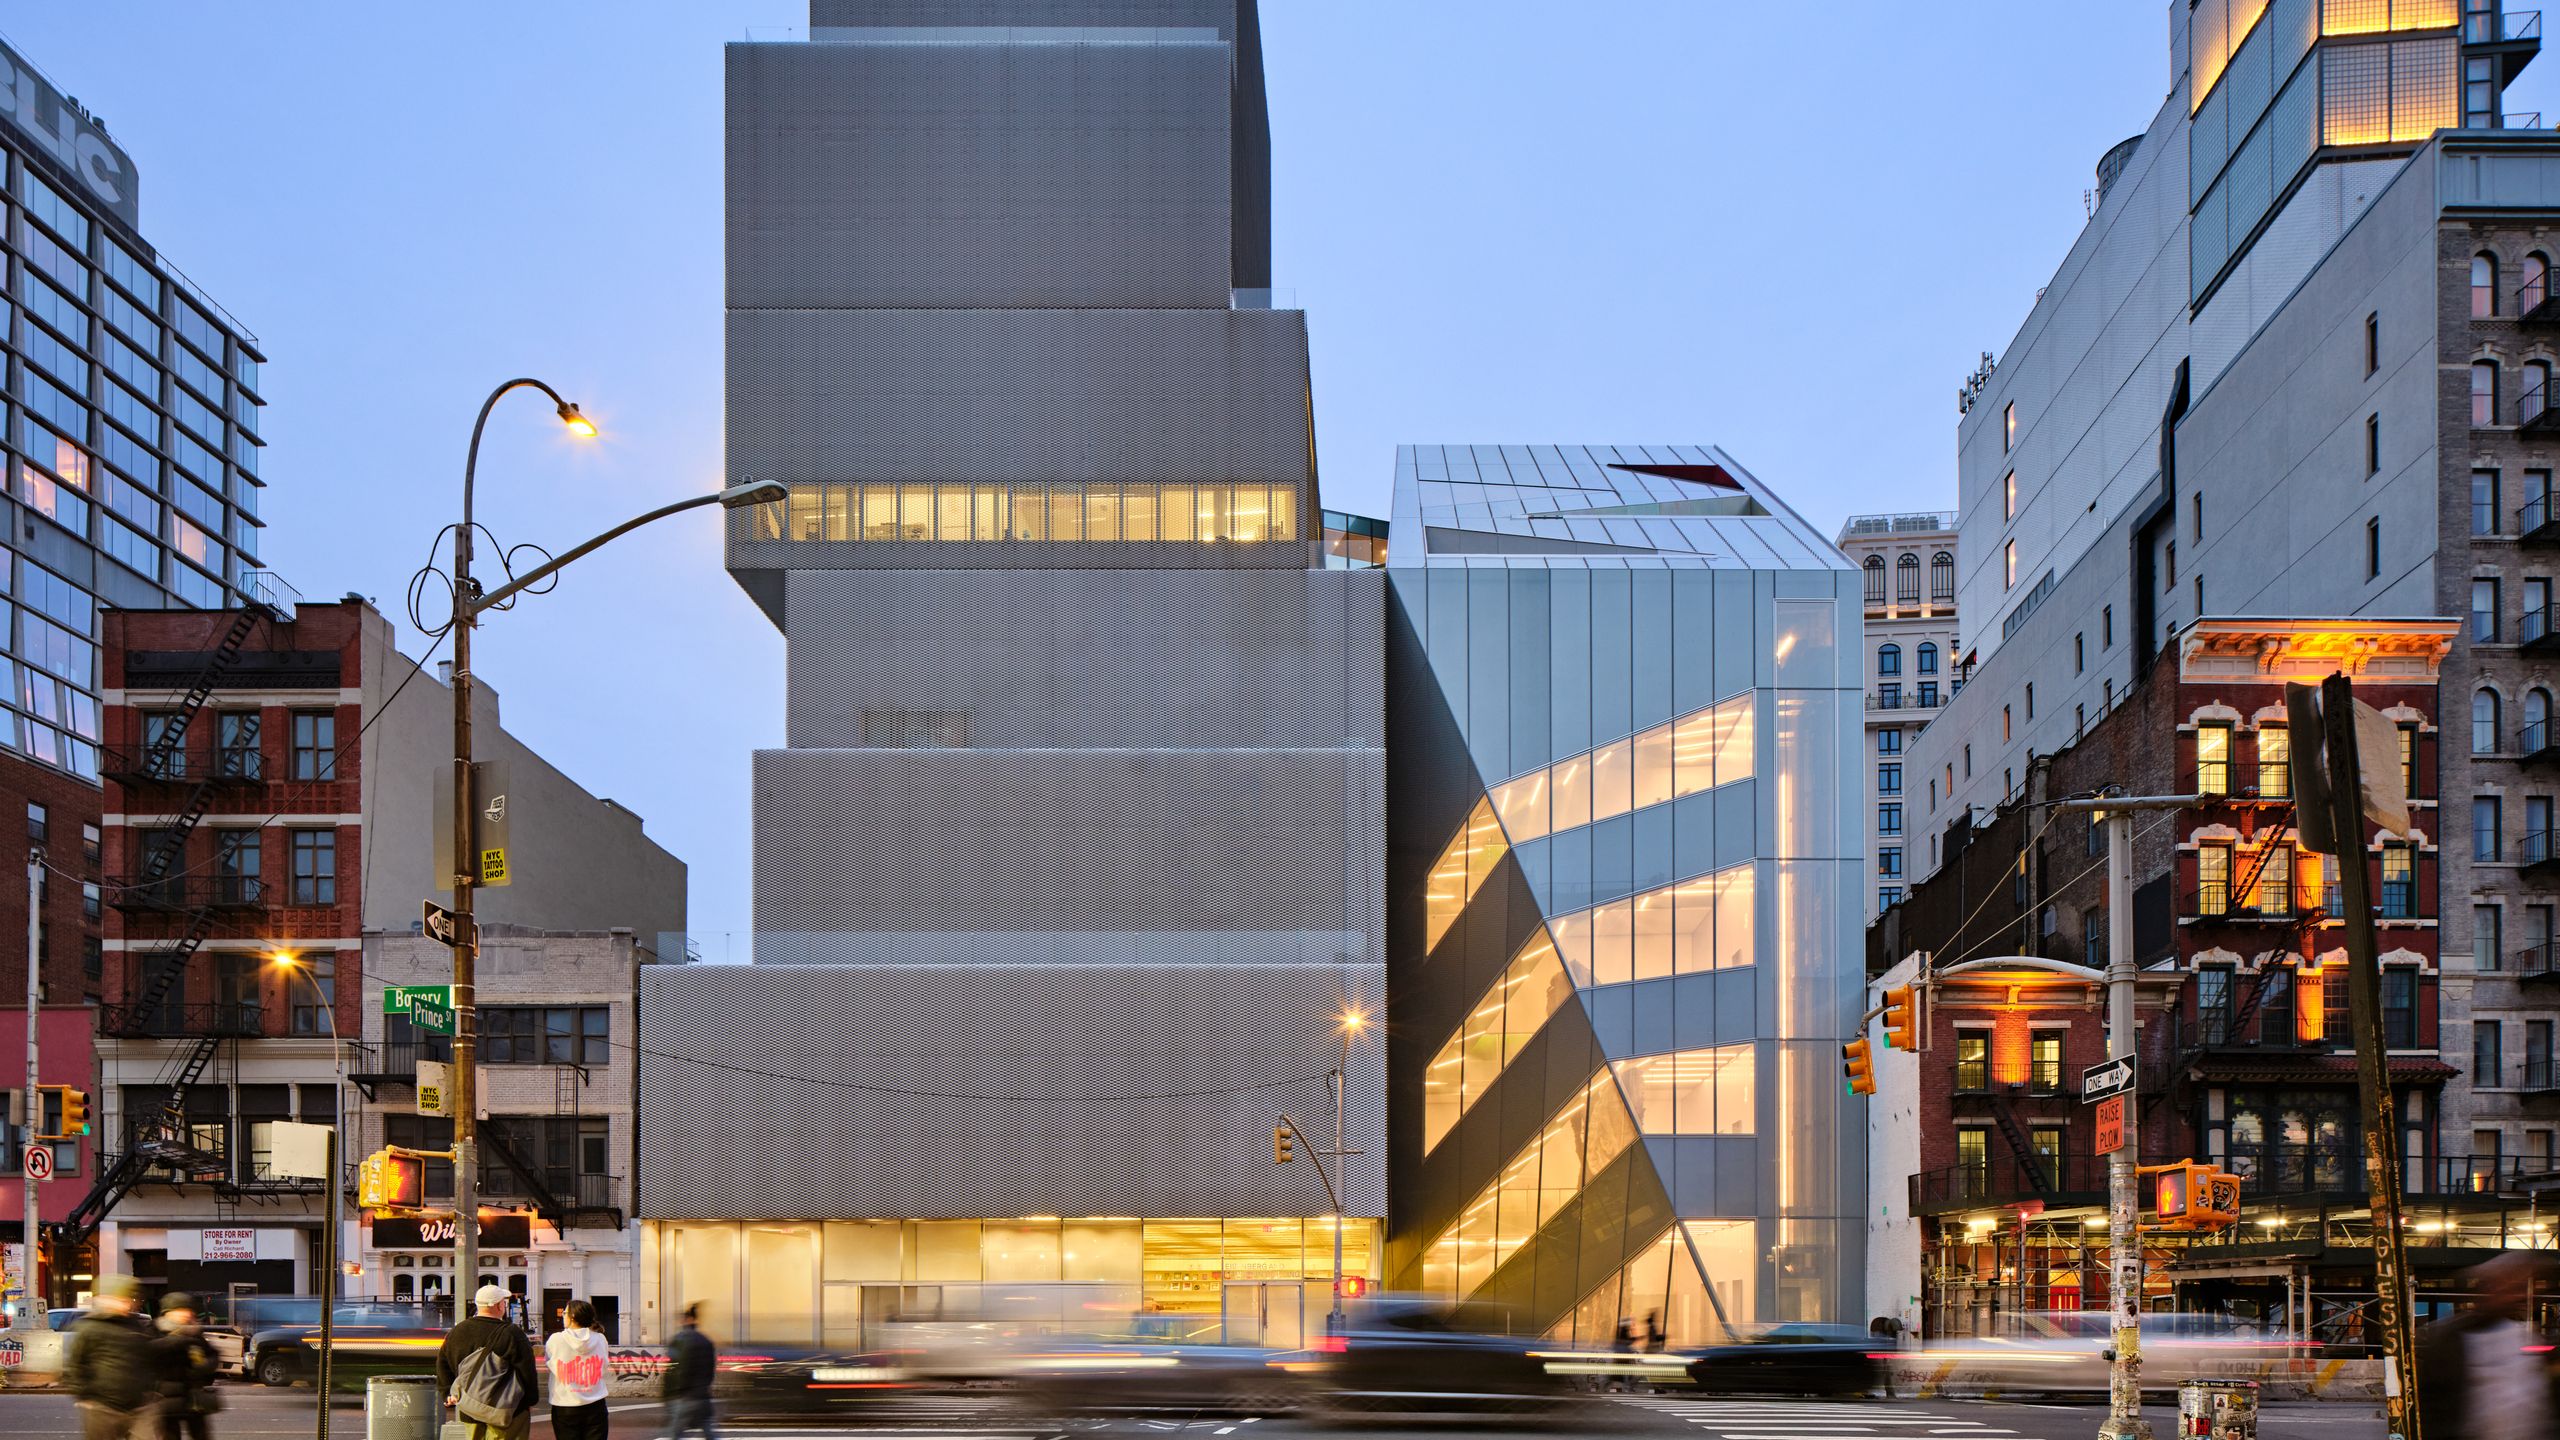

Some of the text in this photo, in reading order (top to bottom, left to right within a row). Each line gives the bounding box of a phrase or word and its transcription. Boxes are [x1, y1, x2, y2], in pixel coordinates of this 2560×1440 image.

[486, 851, 500, 860] NYC
[484, 860, 503, 870] TATTOO
[485, 870, 504, 879] SHOP
[433, 916, 449, 934] ONE
[415, 1002, 452, 1028] Prince St
[2088, 1068, 2124, 1091] ONE WAY
[421, 1094, 439, 1102] TATTOO
[2100, 1104, 2120, 1126] RAISE
[2100, 1128, 2119, 1149] PLOW
